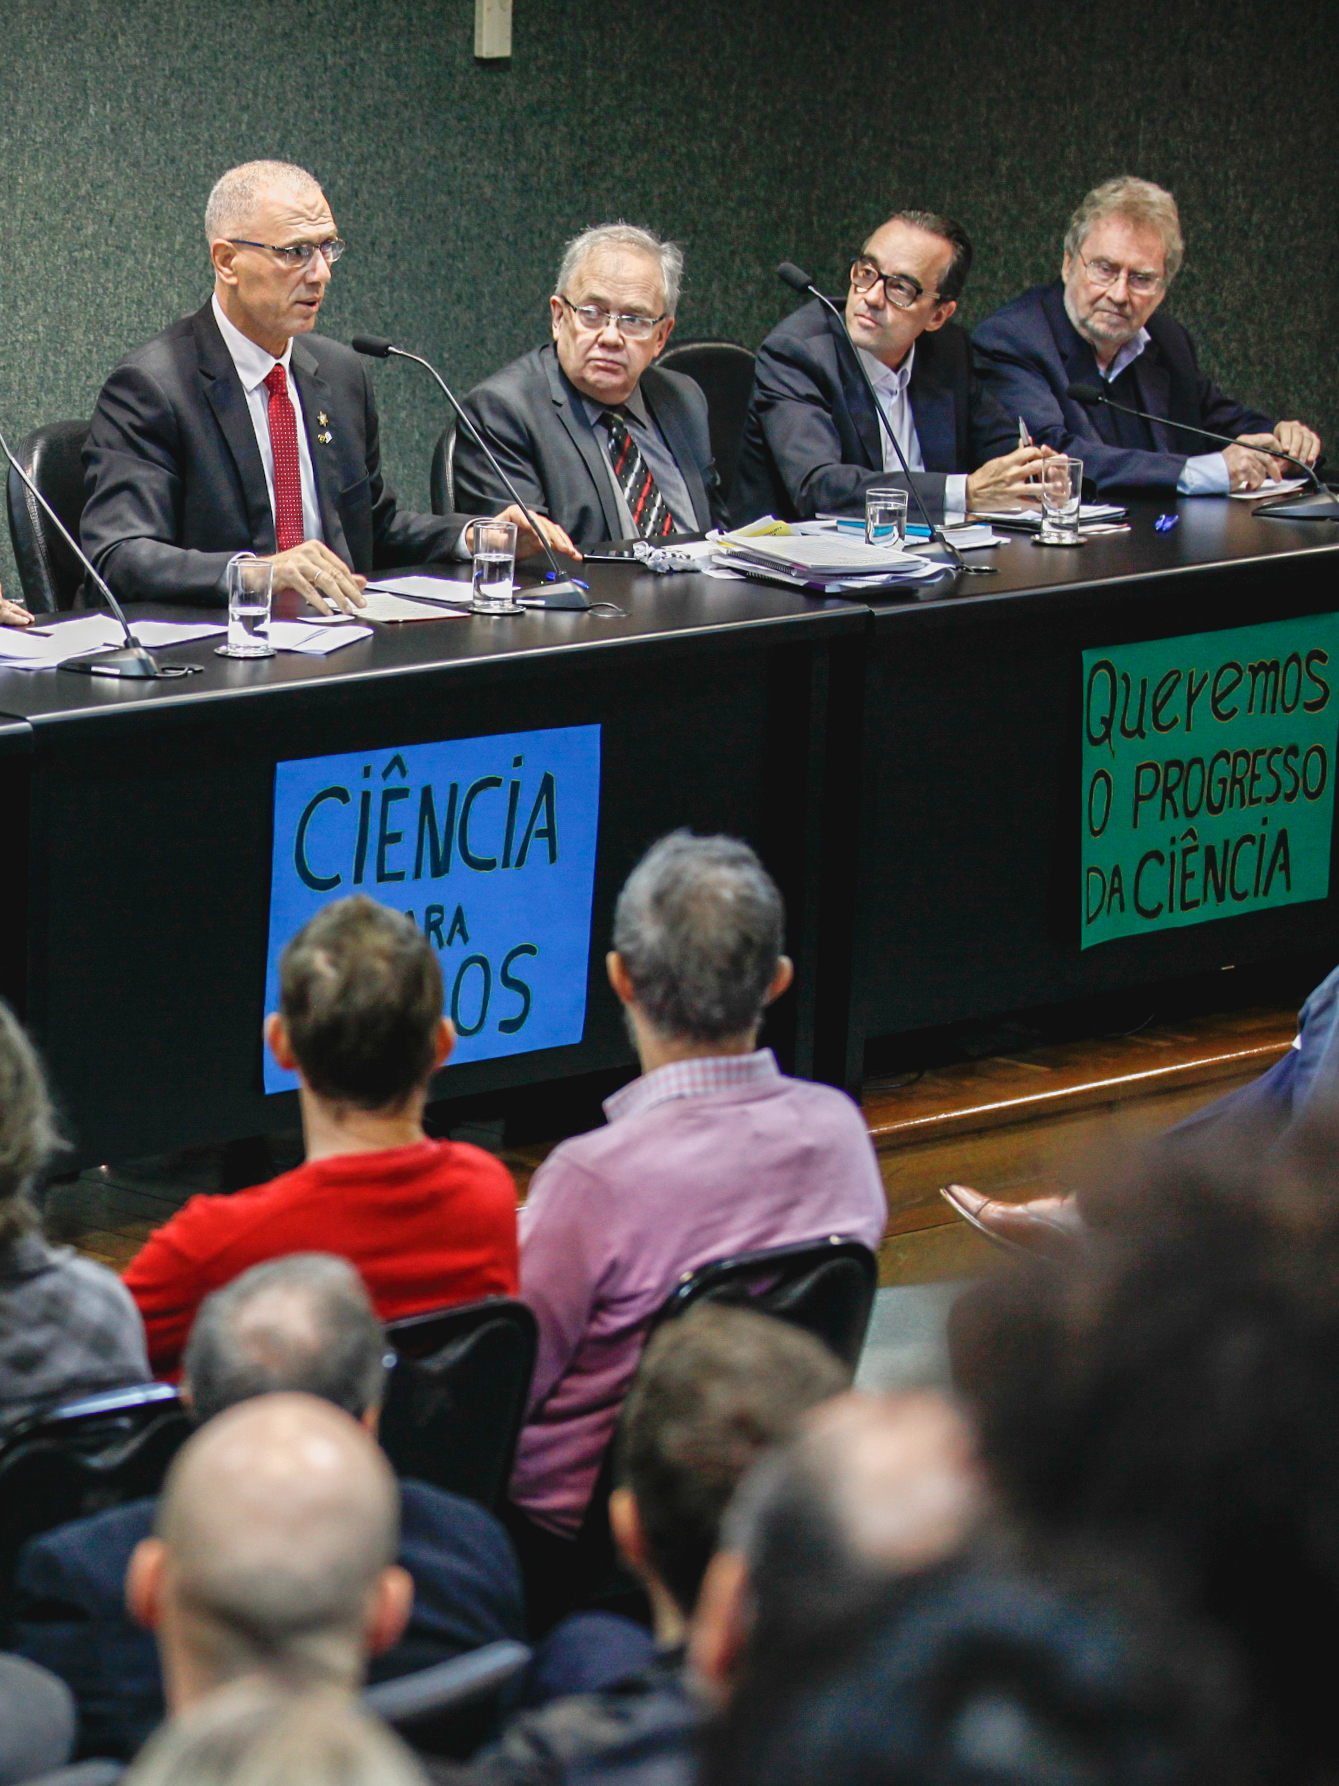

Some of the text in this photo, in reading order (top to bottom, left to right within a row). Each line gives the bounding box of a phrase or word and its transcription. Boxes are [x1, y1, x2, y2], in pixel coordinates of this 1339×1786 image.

[1088, 744, 1328, 839] O PROGRESSO
[1085, 863, 1125, 927] DA
